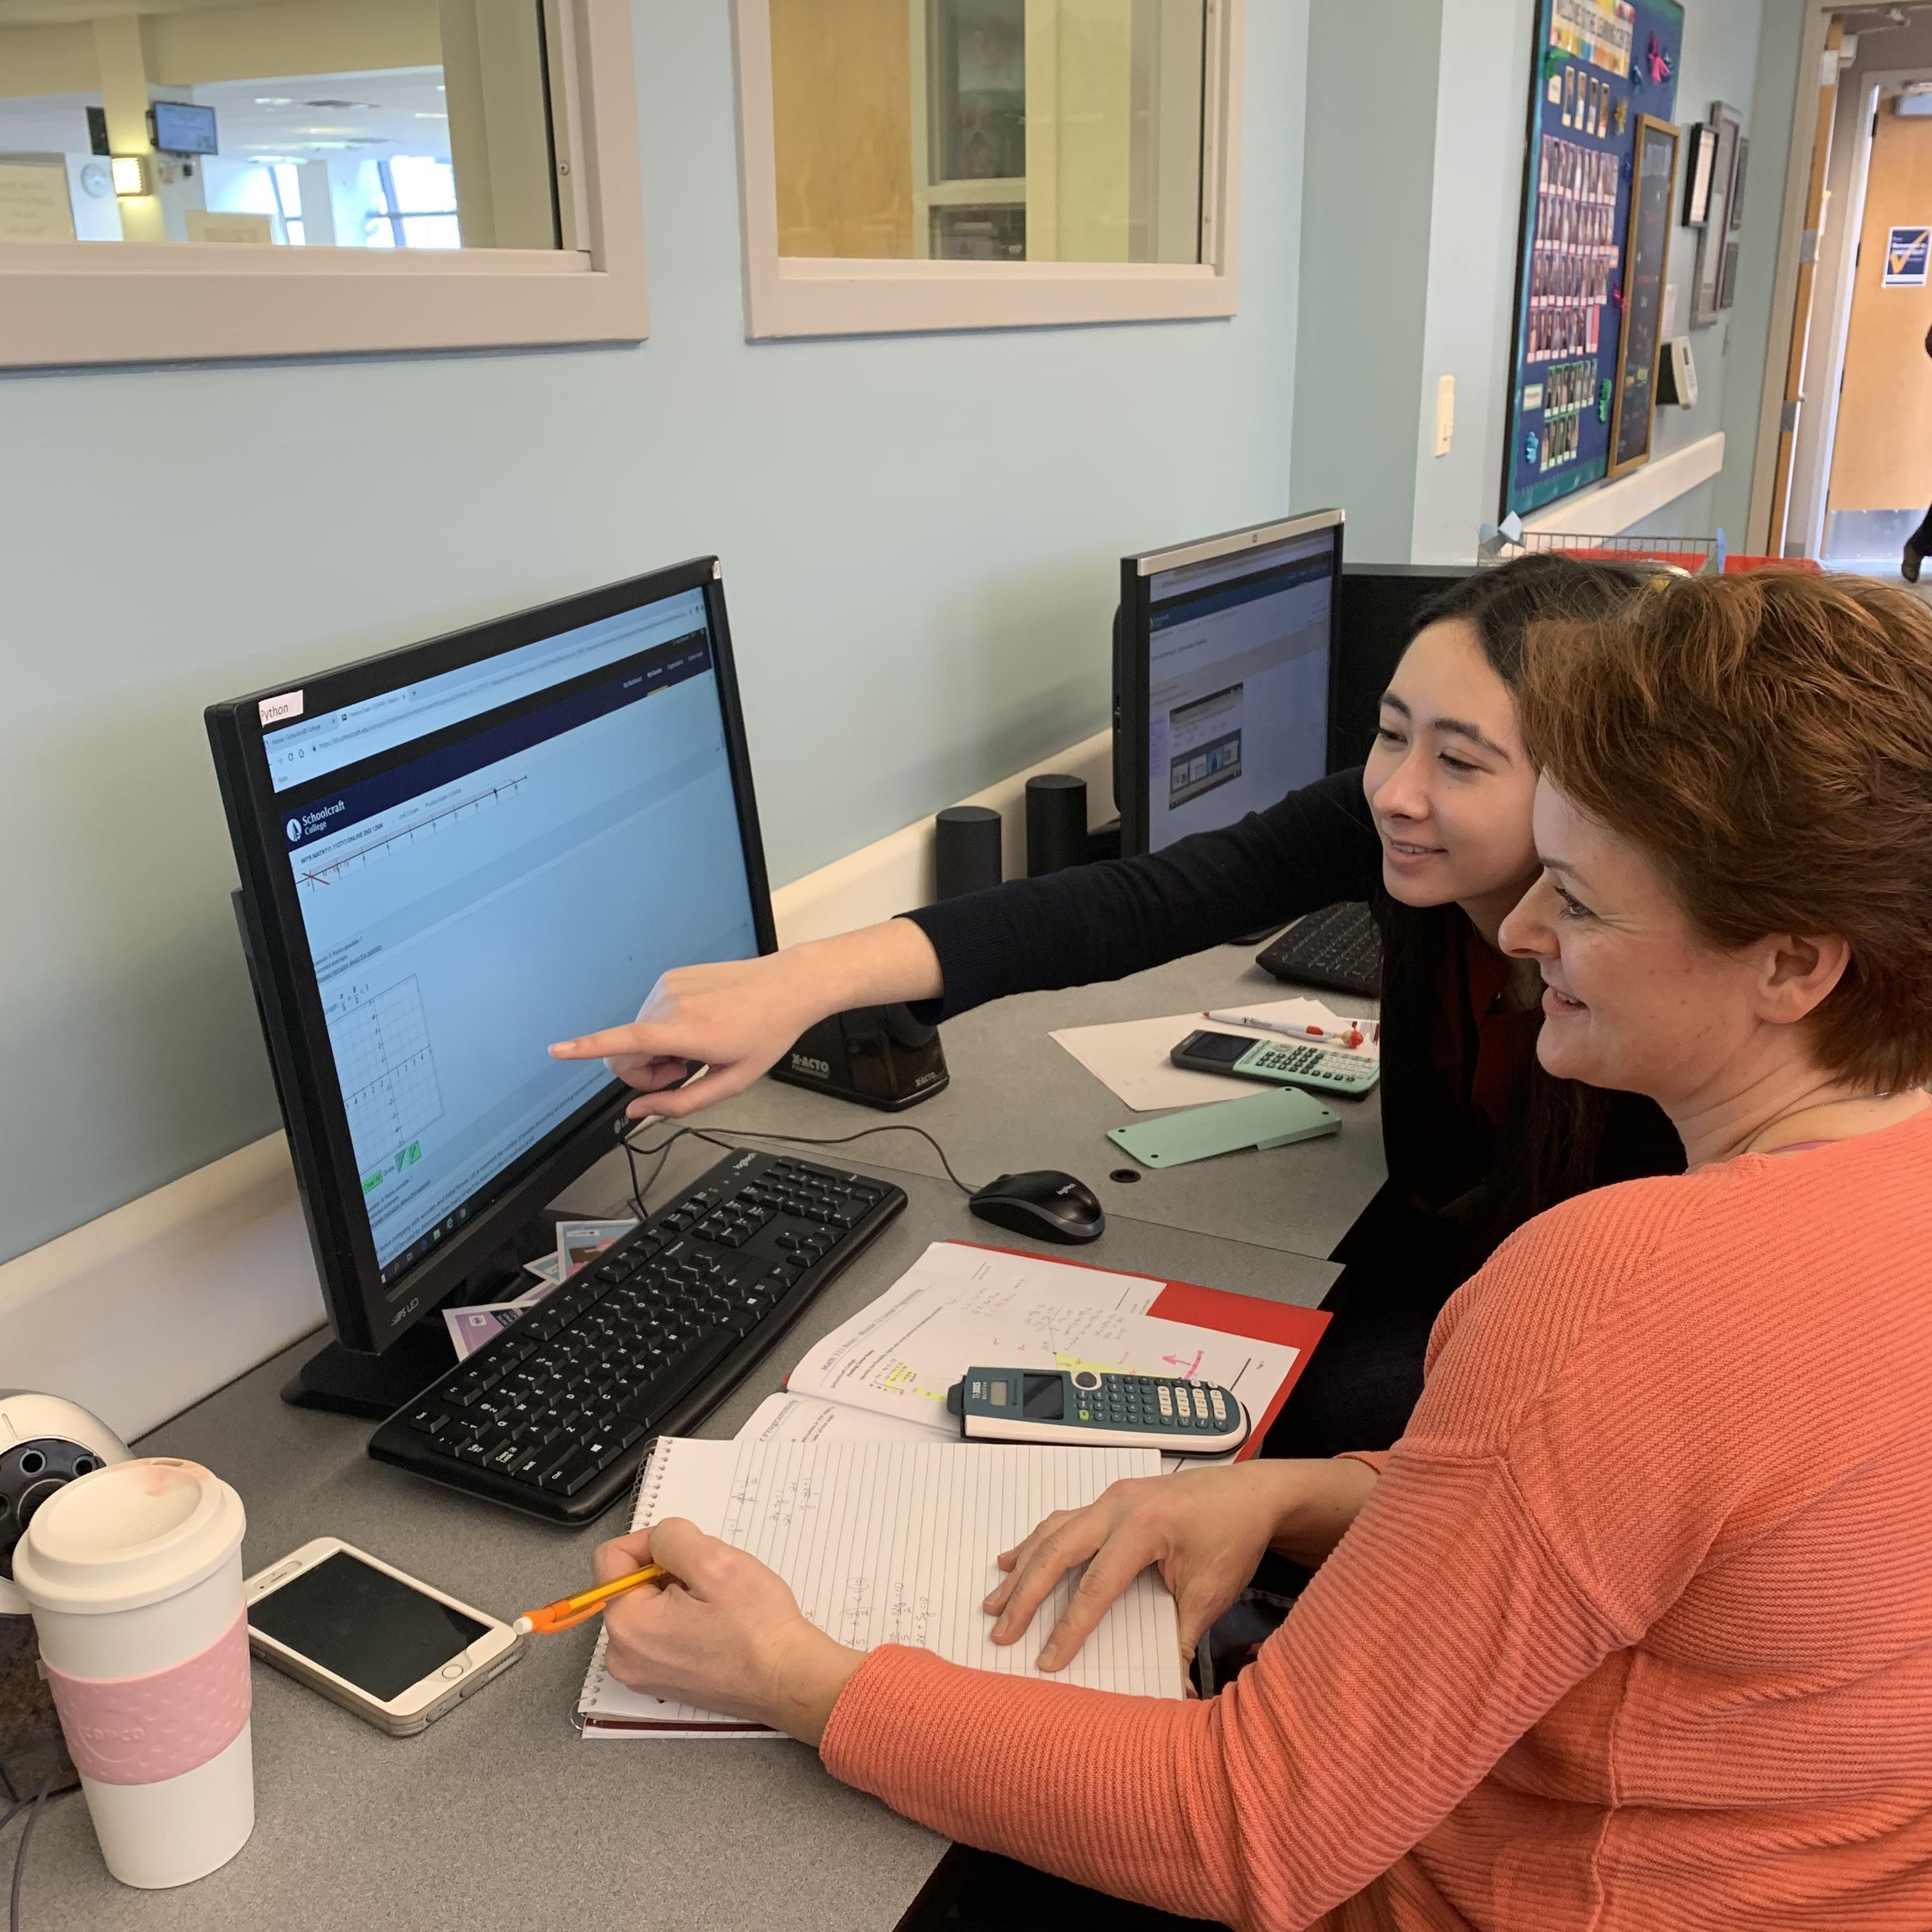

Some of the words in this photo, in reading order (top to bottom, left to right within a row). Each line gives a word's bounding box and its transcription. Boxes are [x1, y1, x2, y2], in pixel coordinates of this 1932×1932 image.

[261, 703, 288, 721] Python
[302, 800, 346, 825] Schoolcraft
[304, 820, 327, 836] College
[792, 1054, 829, 1073] X-ACTO
[915, 1072, 937, 1087] X-ACTO
[822, 1355, 837, 1371] Math
[834, 1346, 845, 1359] 111
[972, 1381, 981, 1399] TI-30XS
